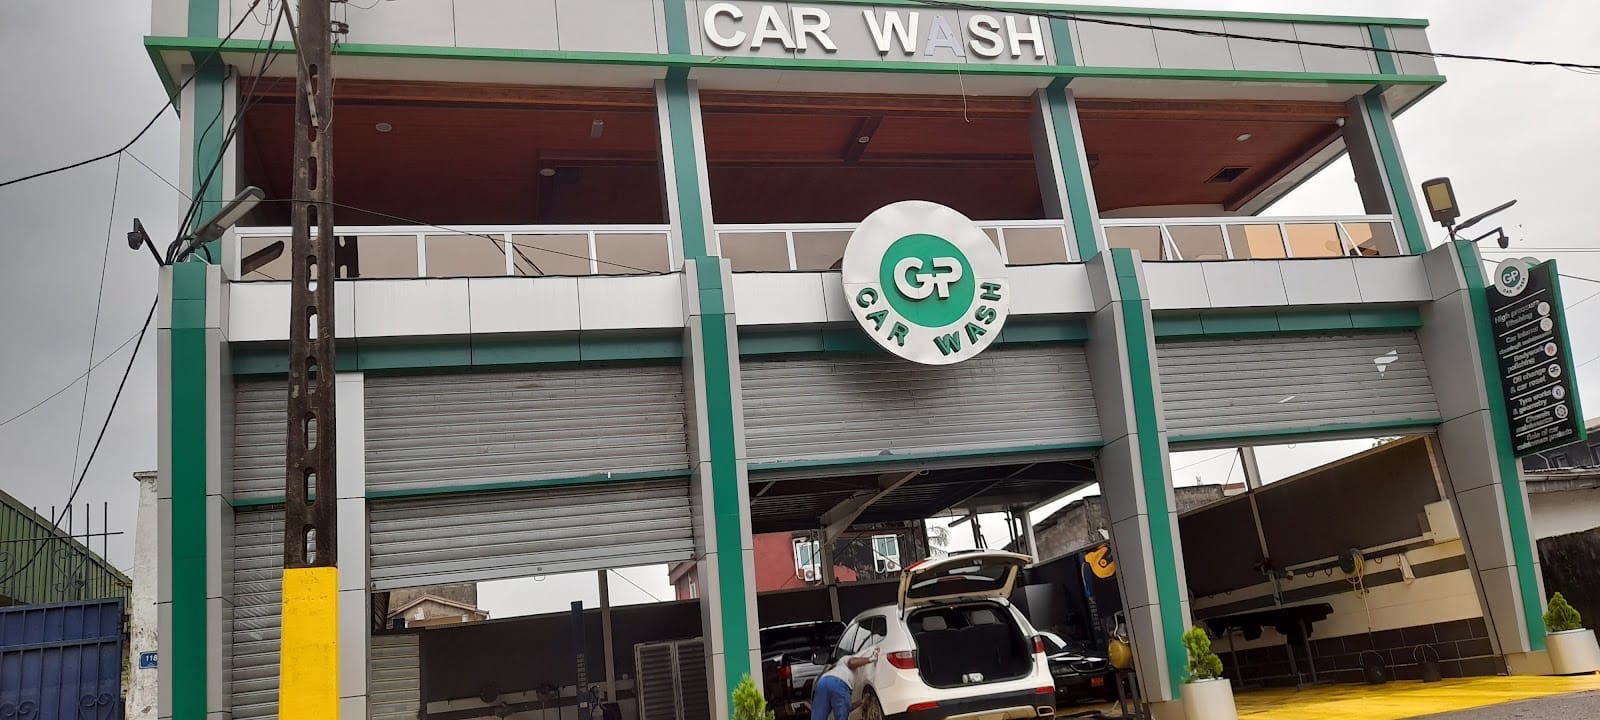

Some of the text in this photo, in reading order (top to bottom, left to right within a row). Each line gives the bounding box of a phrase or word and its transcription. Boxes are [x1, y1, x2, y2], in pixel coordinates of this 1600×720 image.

[703, 3, 1045, 60] CAR WASH
[893, 256, 963, 302] GP
[1502, 270, 1519, 285] GP
[856, 281, 1002, 356] CAR WASH
[1494, 312, 1511, 324] High
[1512, 367, 1547, 384] Oil change
[1516, 382, 1529, 392] car
[1518, 396, 1533, 407] Tyre
[145, 654, 158, 662] 118
